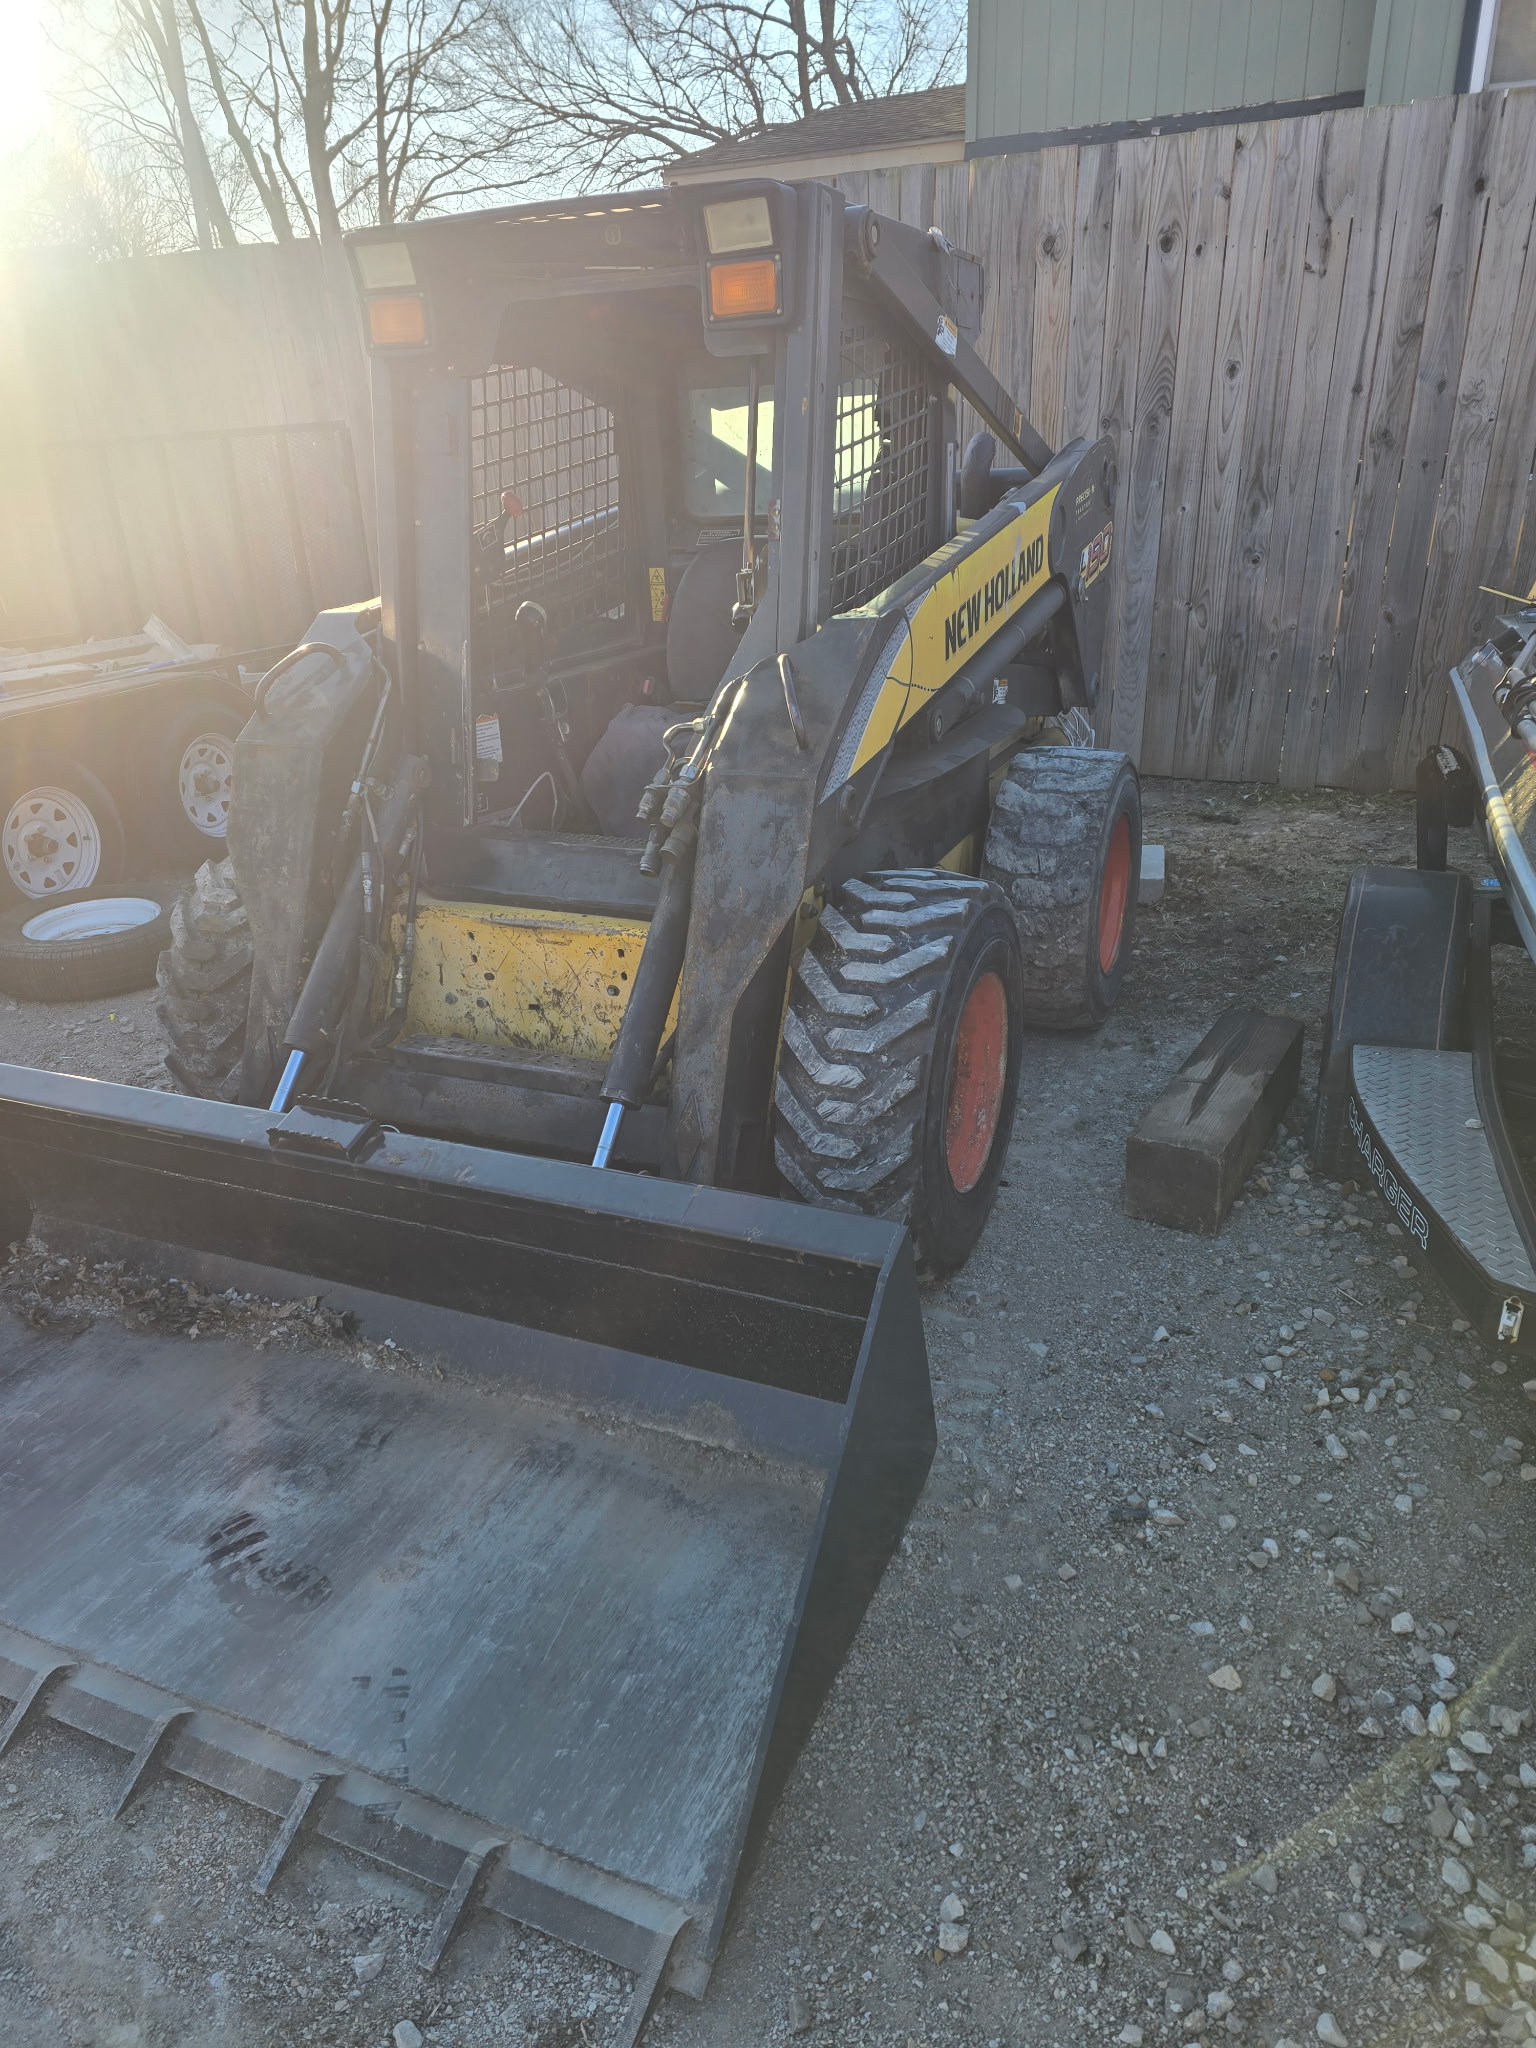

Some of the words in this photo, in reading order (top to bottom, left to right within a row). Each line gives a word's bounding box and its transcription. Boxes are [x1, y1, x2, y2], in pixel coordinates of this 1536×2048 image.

[945, 588, 981, 662] NEW
[985, 534, 1043, 624] HOLLAND
[1350, 1096, 1429, 1251] CHARGER
